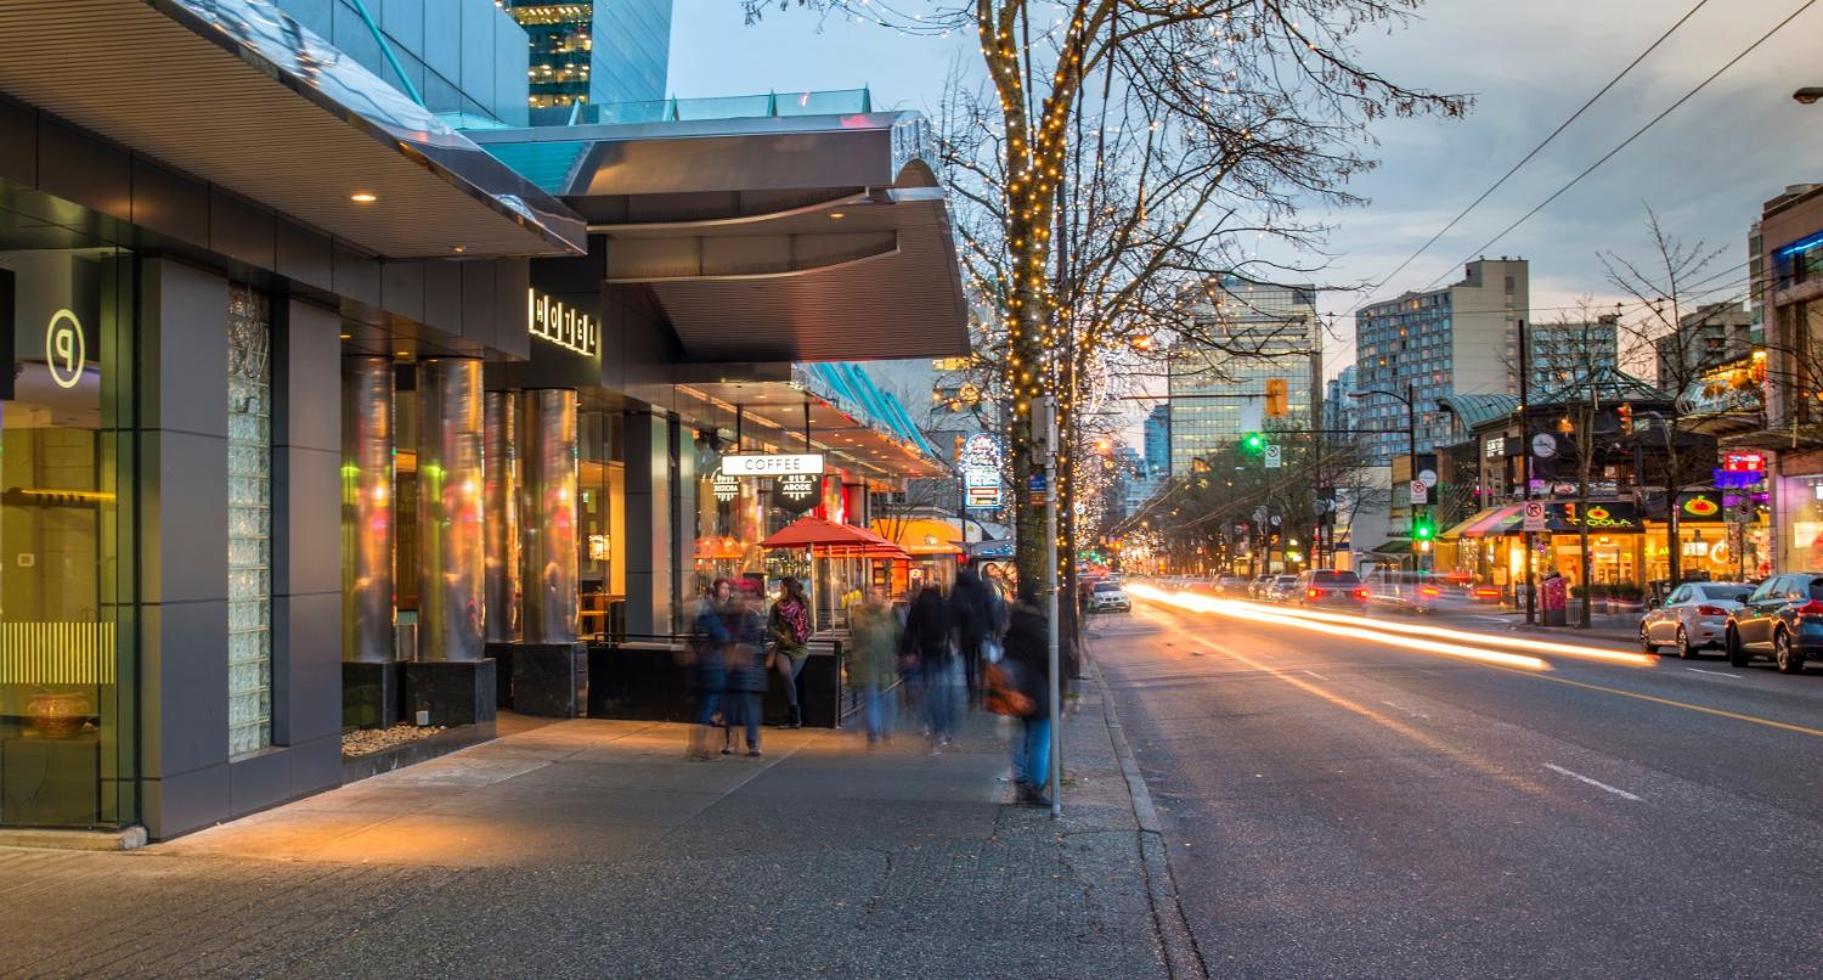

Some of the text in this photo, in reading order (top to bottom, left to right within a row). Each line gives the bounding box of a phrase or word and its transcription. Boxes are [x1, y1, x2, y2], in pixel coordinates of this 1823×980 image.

[536, 299, 596, 346] HOTEL
[745, 459, 801, 470] COFFEE
[783, 483, 812, 491] ABODE
